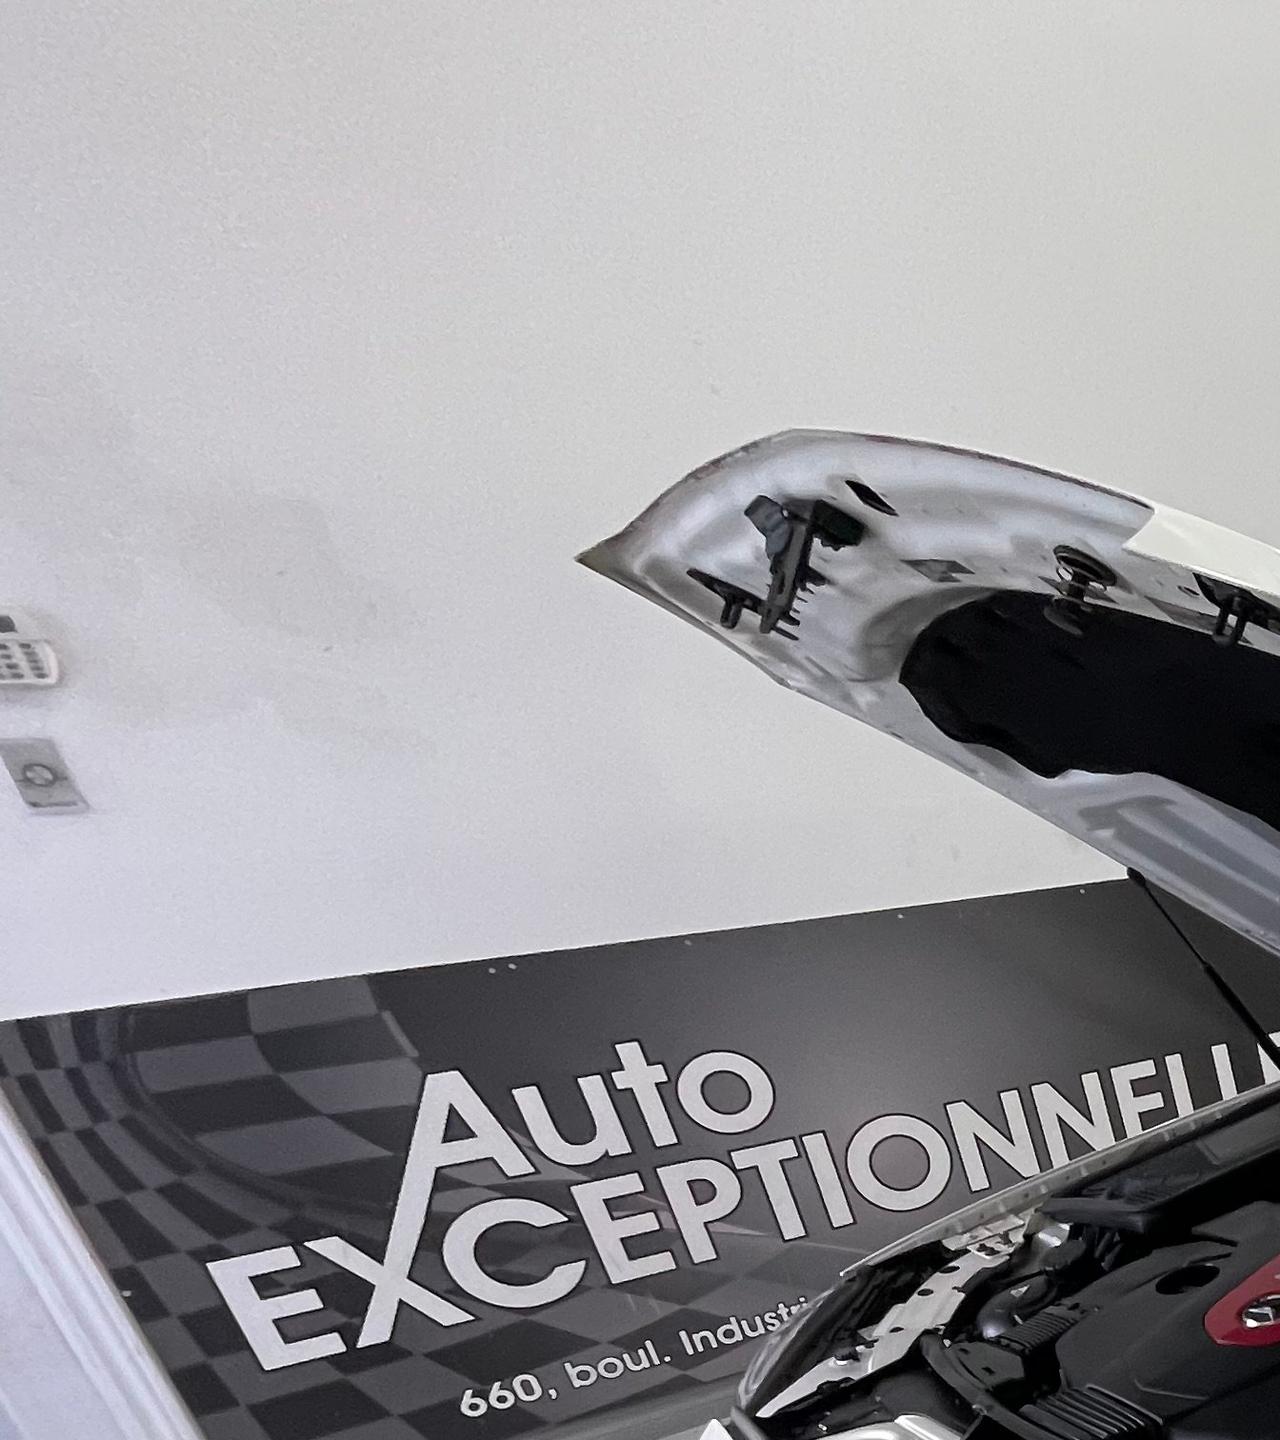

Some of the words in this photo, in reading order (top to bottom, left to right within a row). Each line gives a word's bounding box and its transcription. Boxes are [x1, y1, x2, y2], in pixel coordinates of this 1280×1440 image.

[404, 1040, 775, 1178] Auto
[459, 1374, 558, 1417] 660,
[564, 1340, 672, 1388] boul.
